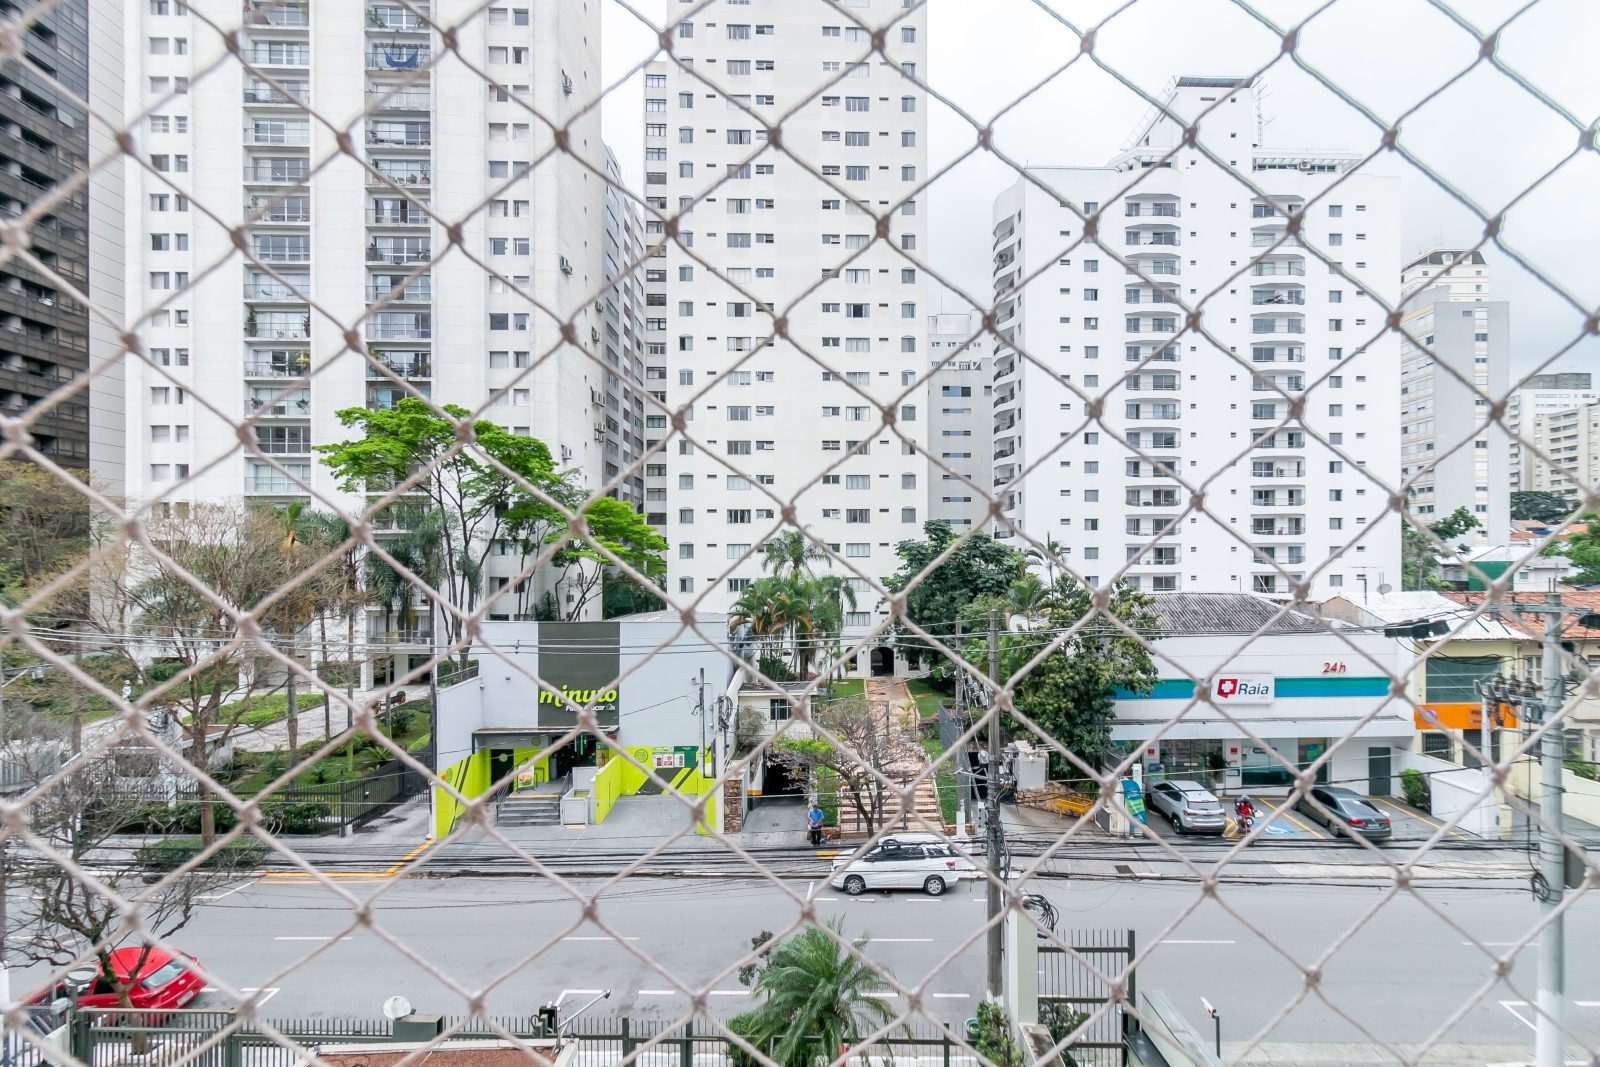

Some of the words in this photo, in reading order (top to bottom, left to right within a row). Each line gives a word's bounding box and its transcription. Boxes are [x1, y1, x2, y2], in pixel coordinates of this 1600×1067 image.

[1323, 661, 1346, 673] 24h
[1237, 683, 1269, 695] Raia
[539, 684, 617, 707] minuto
